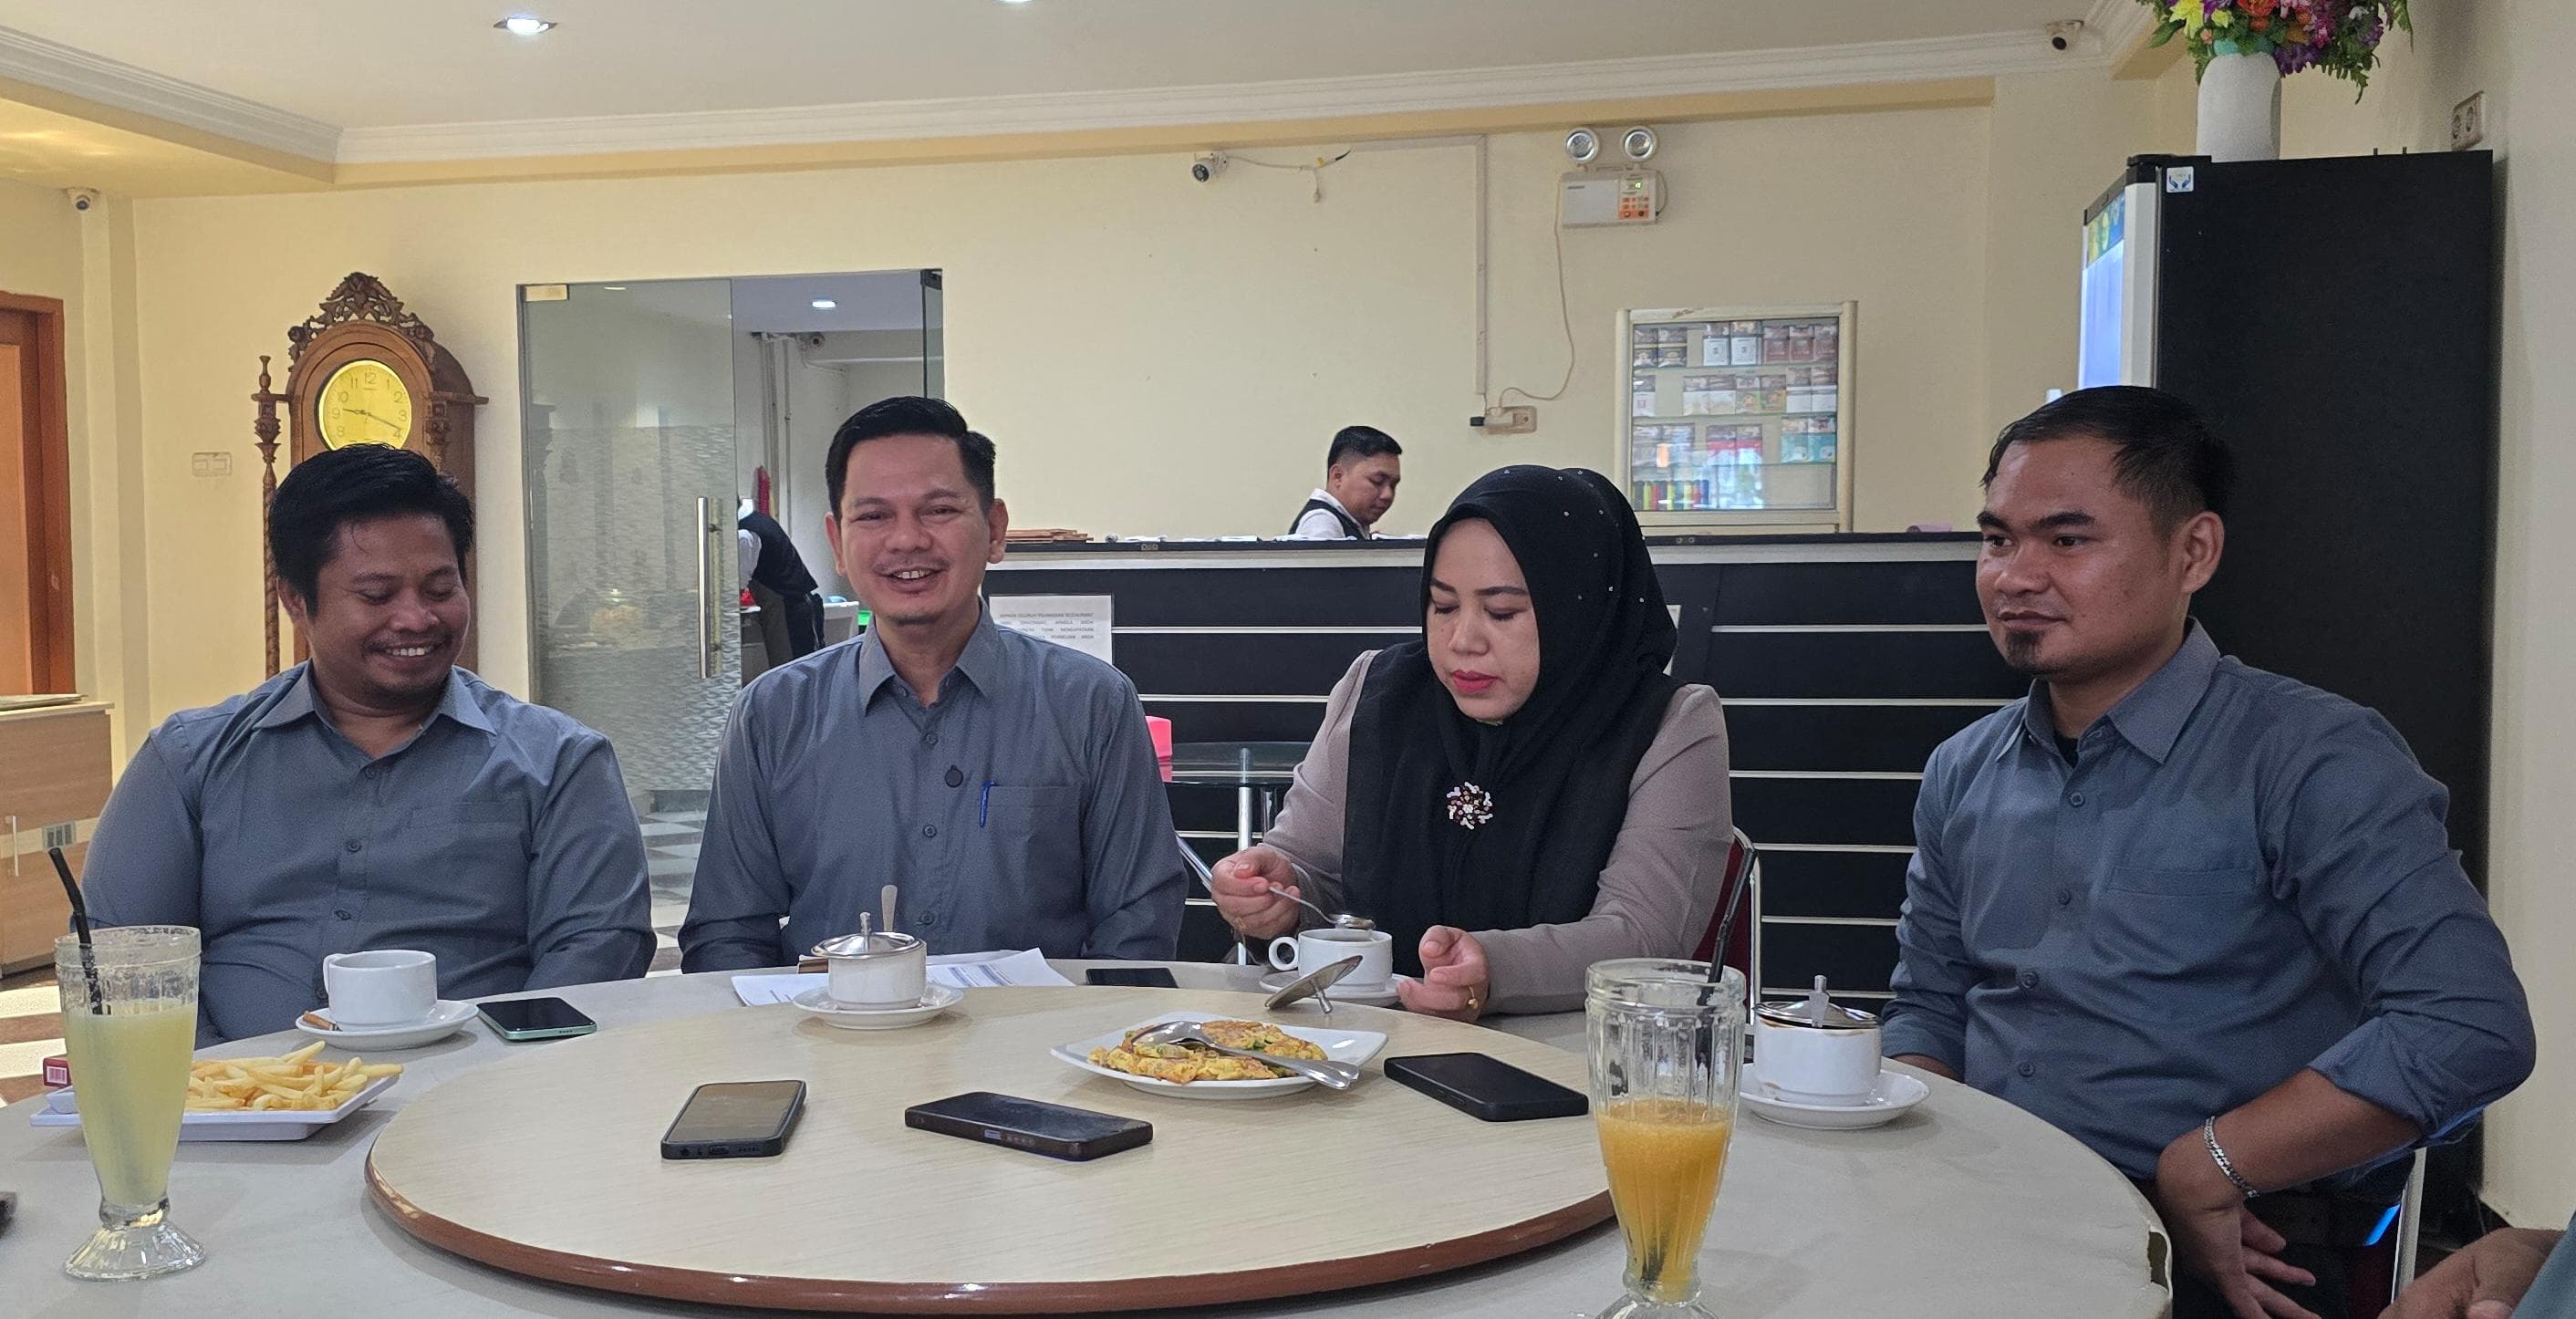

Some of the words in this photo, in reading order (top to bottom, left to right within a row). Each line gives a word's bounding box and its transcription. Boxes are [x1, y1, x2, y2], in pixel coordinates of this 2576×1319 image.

[350, 377, 358, 389] 11
[364, 372, 377, 385] 12
[386, 379, 390, 389] 1
[337, 390, 348, 403] 10
[393, 390, 404, 403] 2
[331, 408, 341, 420] 9
[398, 410, 408, 421] 3
[336, 426, 345, 437] 8
[393, 428, 402, 439] 4
